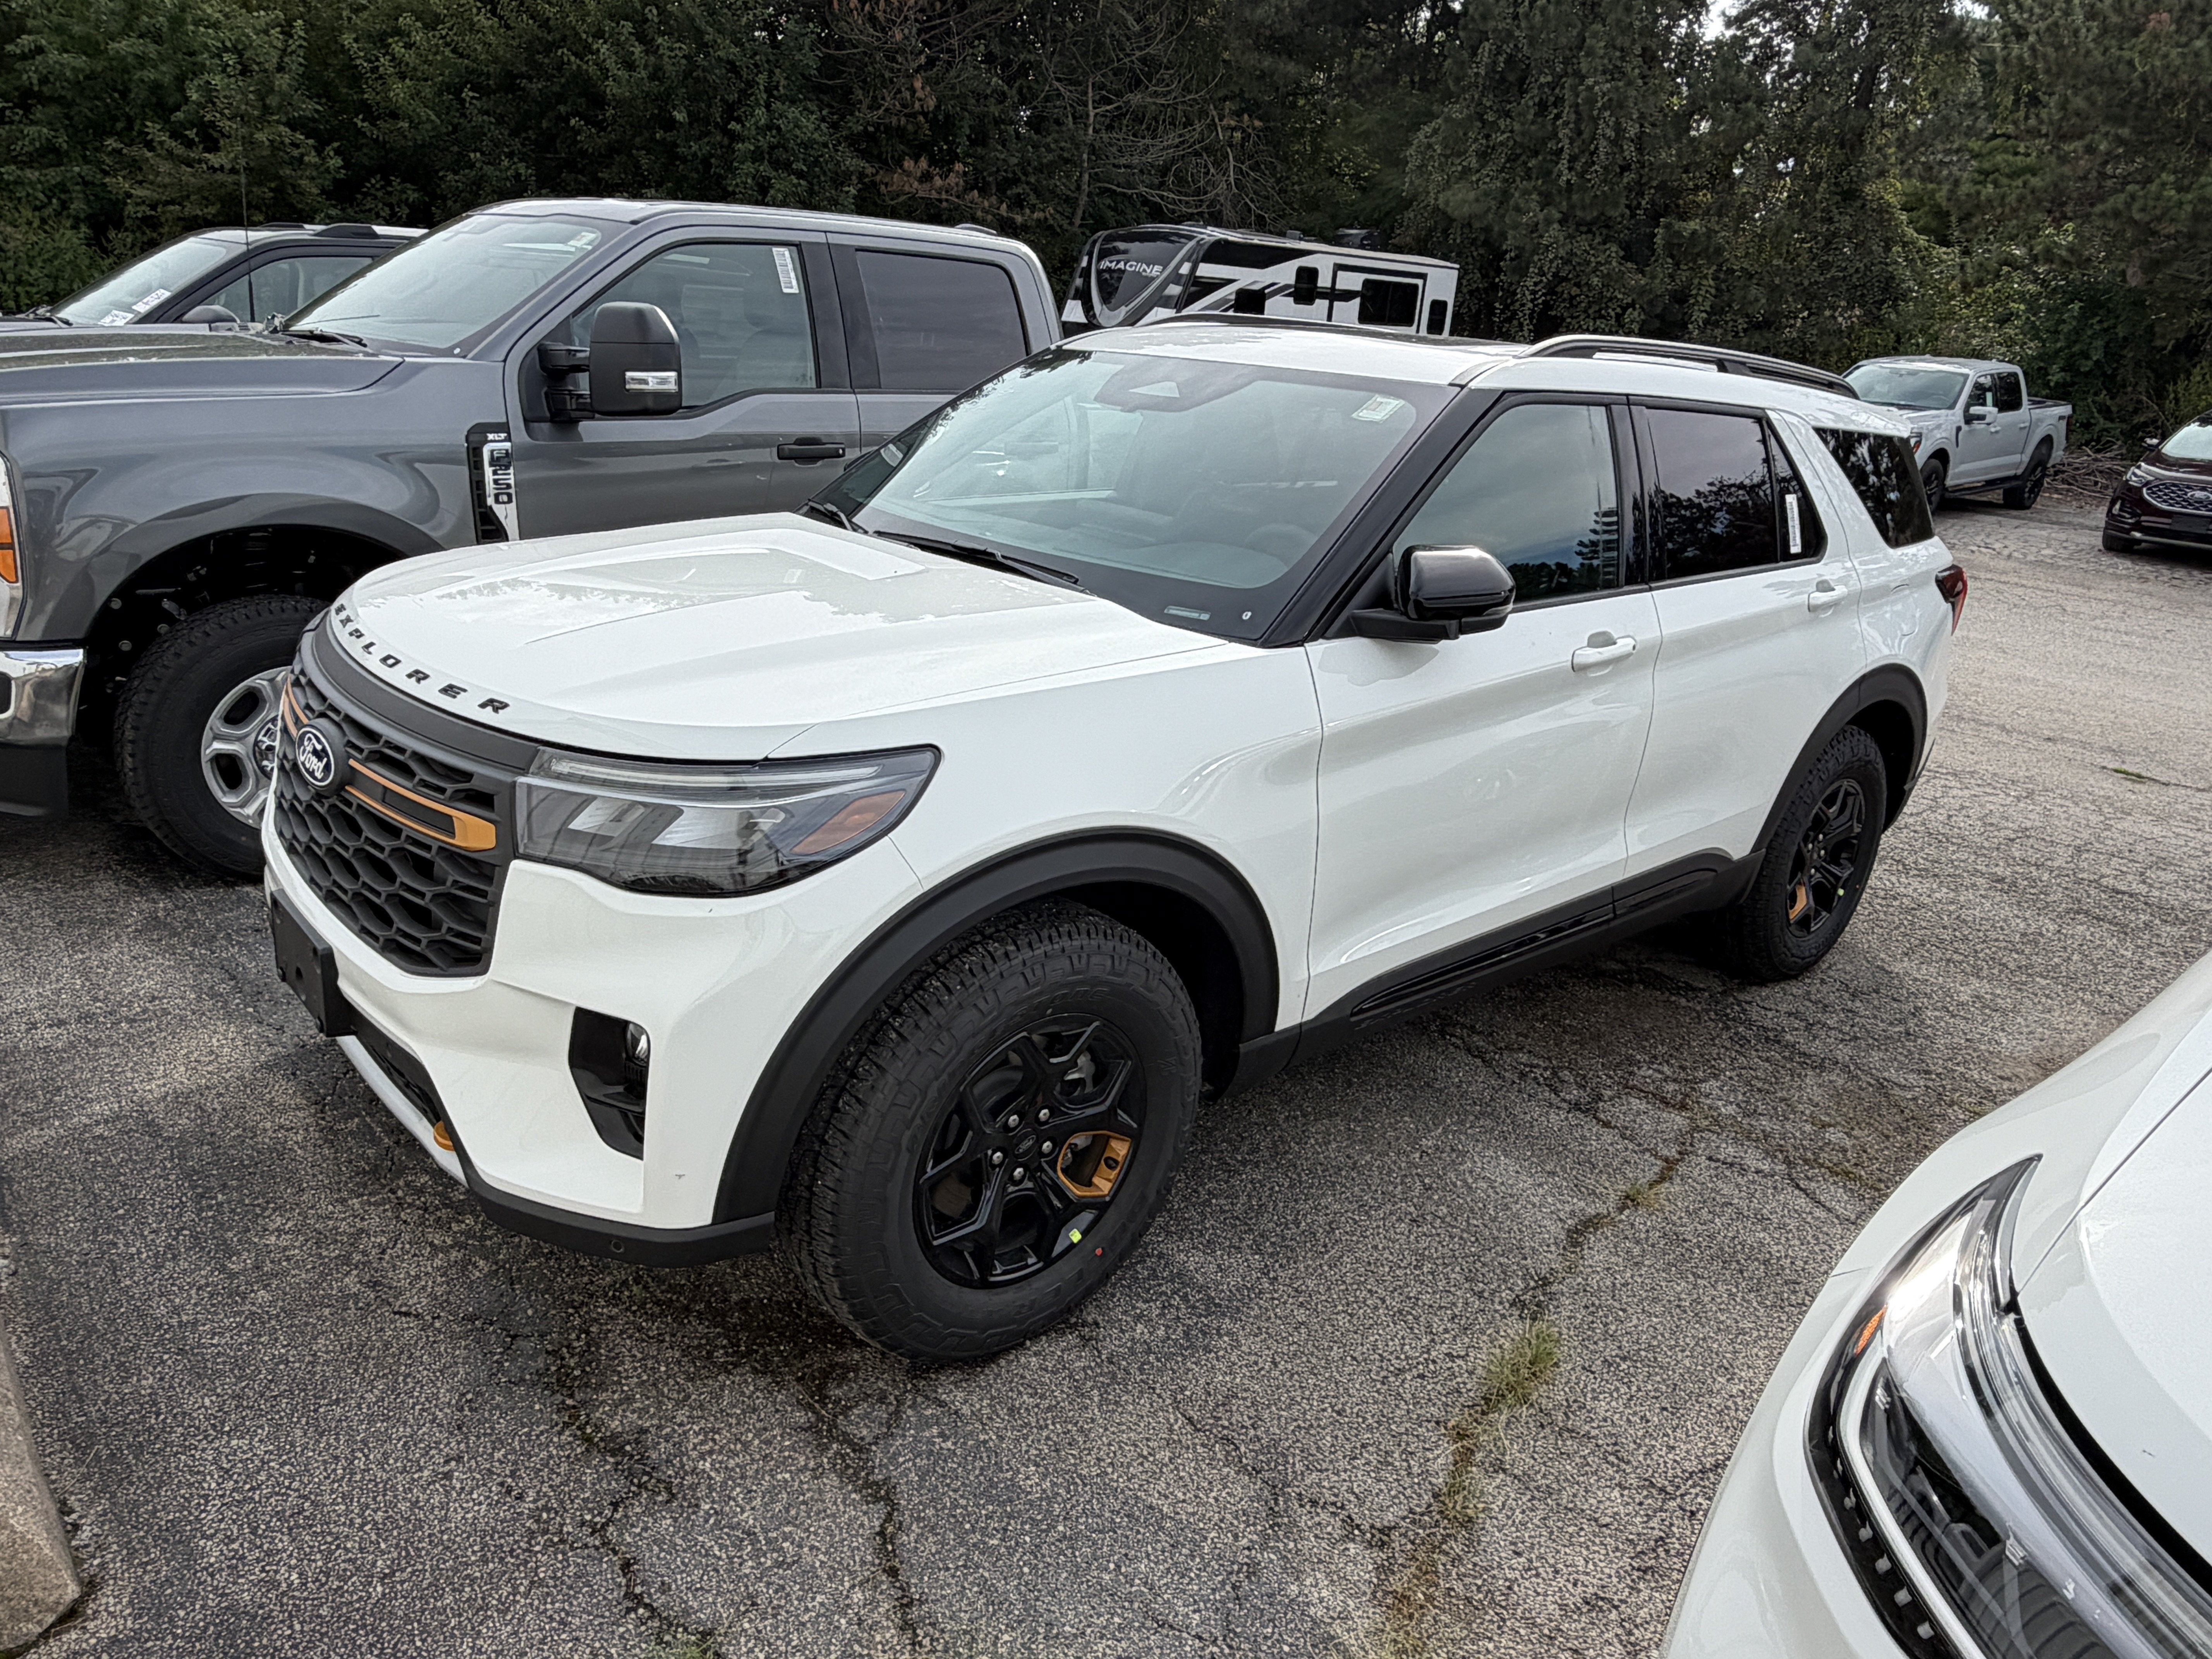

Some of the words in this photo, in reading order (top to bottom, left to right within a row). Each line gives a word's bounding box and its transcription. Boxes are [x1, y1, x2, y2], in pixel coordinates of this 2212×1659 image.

[1099, 259, 1163, 275] IMAGINE
[334, 603, 510, 714] EXPLORER
[299, 732, 328, 780] Ford
